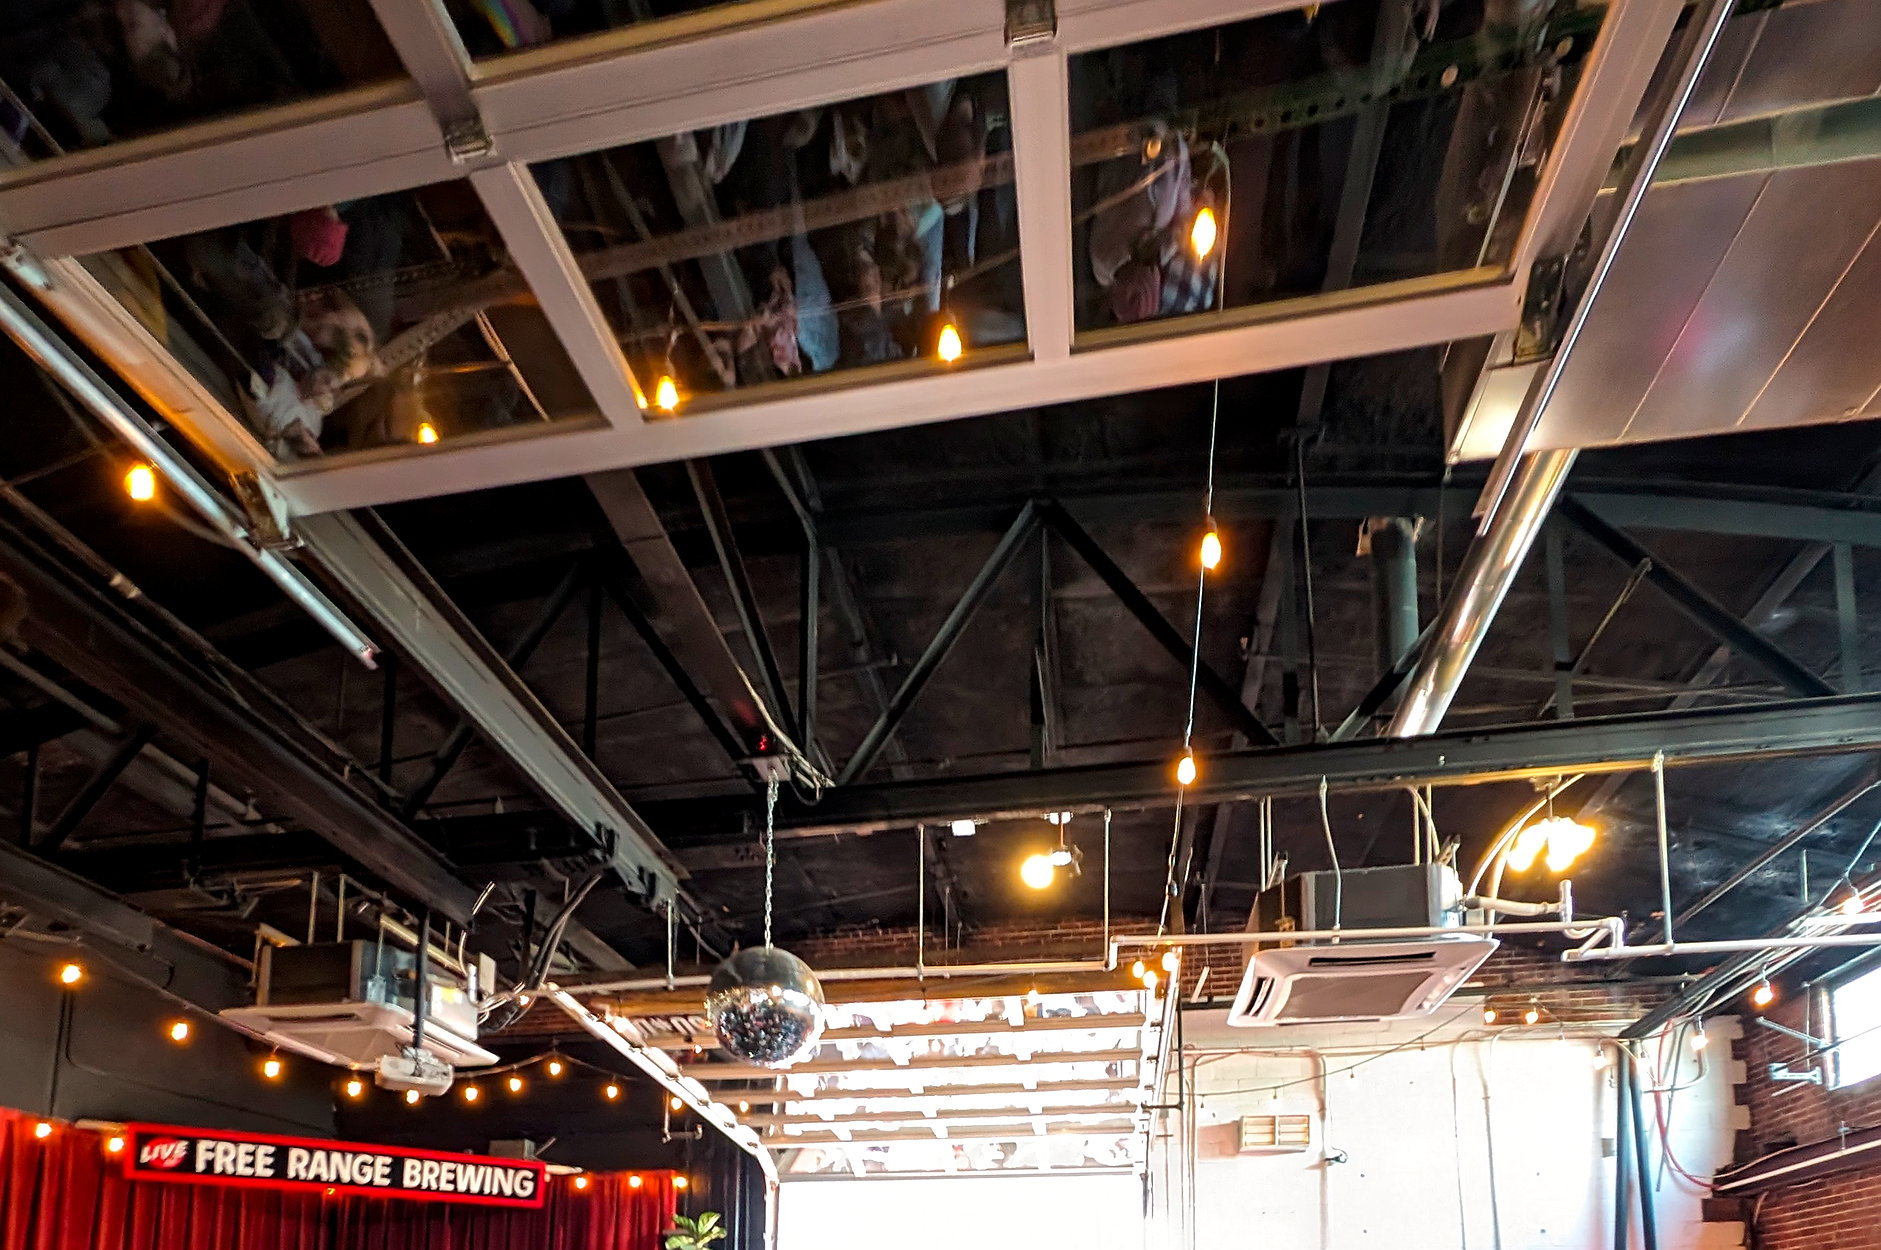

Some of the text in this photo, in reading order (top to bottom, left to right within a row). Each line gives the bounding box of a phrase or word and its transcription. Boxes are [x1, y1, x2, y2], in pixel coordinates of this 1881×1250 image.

[139, 1140, 190, 1163] LIVE
[195, 1139, 535, 1198] FREE RANGE BREWING
